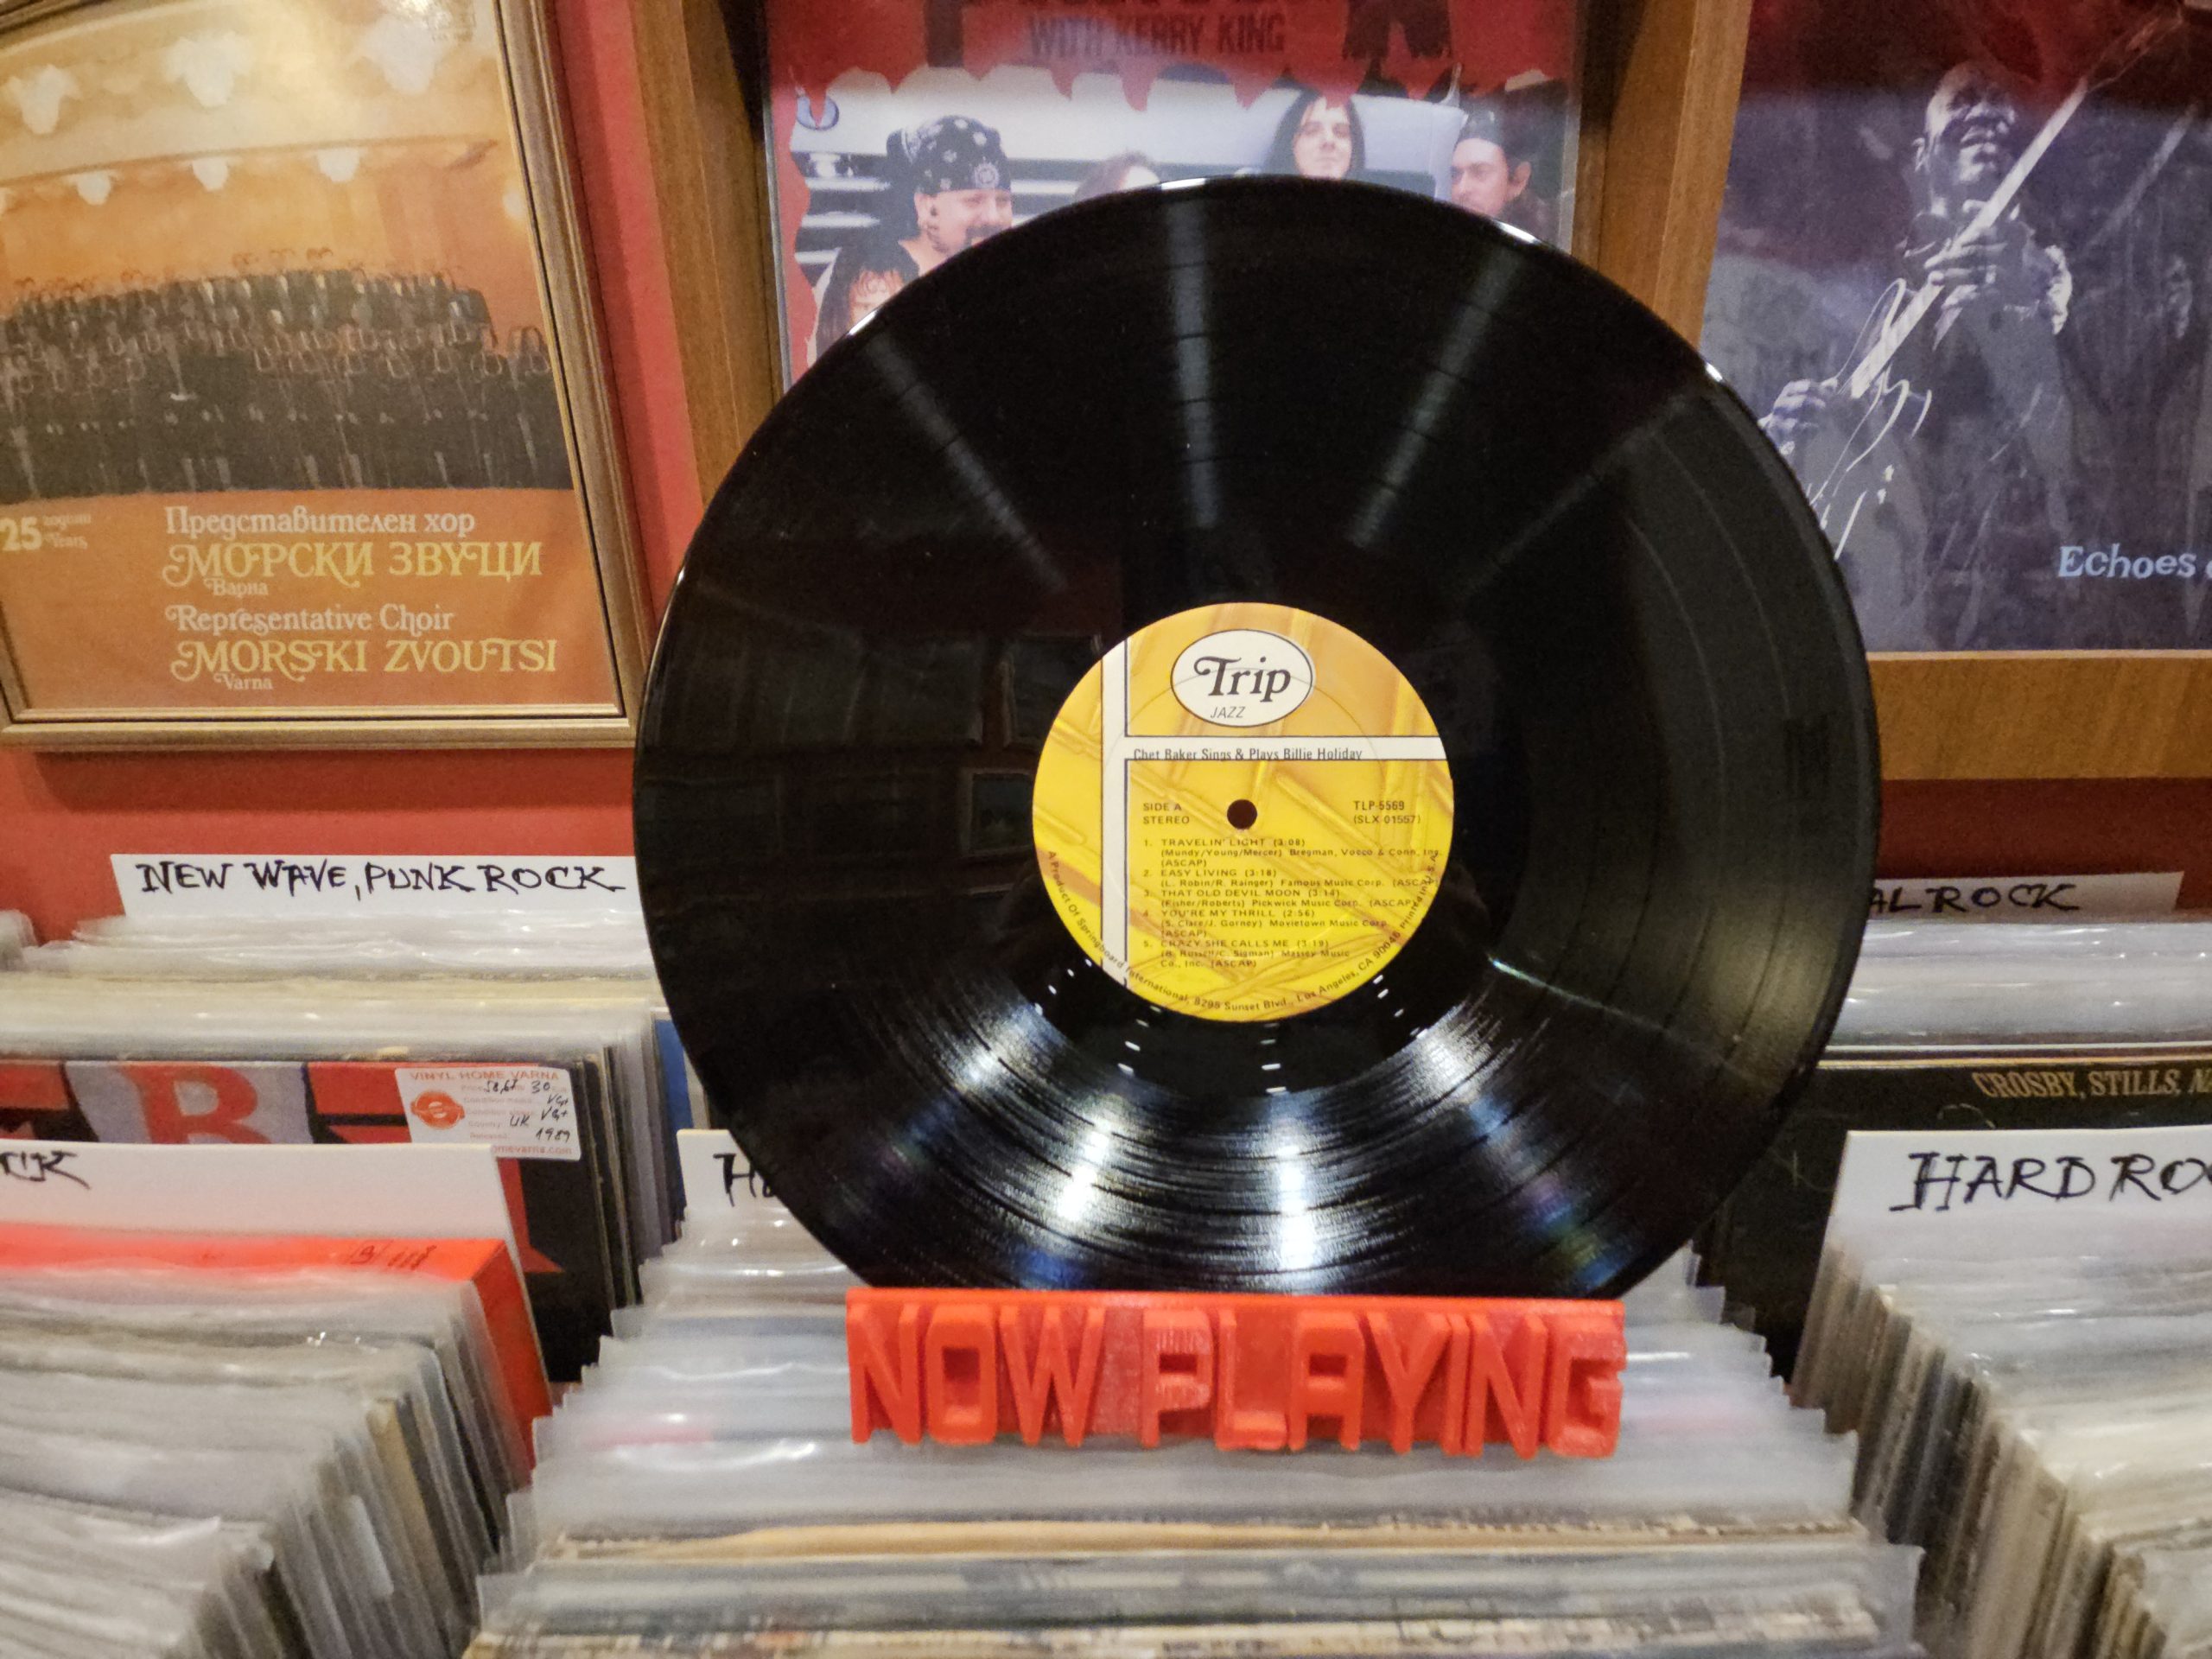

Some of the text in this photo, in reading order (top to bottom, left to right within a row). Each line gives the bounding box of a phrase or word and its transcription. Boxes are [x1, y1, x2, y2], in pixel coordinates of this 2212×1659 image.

[1113, 12, 1204, 54] KERRY
[1217, 12, 1287, 53] KING
[0, 517, 41, 550] 25
[164, 505, 475, 541] Представителен хор
[162, 541, 543, 588] МОРСКИ ЗВУЦИ
[2058, 543, 2197, 580] Echoes
[203, 577, 269, 598] Варна
[164, 603, 455, 638] Representative Choir
[169, 637, 558, 683] MORSKI ZVOUTSI
[213, 672, 274, 690] Varna
[1194, 656, 1291, 703] Trip
[1210, 706, 1246, 719] JAZZ
[1134, 748, 1363, 761] Chet Baker Sings & Plays Billie Holiday
[1143, 816, 1190, 824] STEREO
[1354, 815, 1421, 824] (SLX 01557)
[1144, 838, 1153, 847] 1.
[1161, 859, 1207, 868] (ASCAP)
[136, 859, 627, 900] NEW WAVE, PUNK ROCK
[1230, 879, 1274, 888] Rainger)
[1924, 882, 2080, 913] ROCK
[1050, 861, 1071, 904] Product
[1068, 904, 1080, 917] Of
[1077, 918, 1124, 969] Springboard
[1224, 1001, 1260, 1011] Sunset
[1297, 990, 1316, 1002] Los
[1358, 957, 1374, 971] CA
[1400, 896, 1423, 930] Printed
[1161, 930, 1207, 938] (ASCAP)
[1211, 959, 1257, 969] (ASCAP)
[410, 1070, 560, 1080] VINYL HOME VARNA
[1971, 1071, 2087, 1100] CROSBY,
[510, 1115, 531, 1127] UK
[1889, 1151, 2212, 1211] HARD RO
[849, 1303, 1626, 1459] NOW PLAYING
